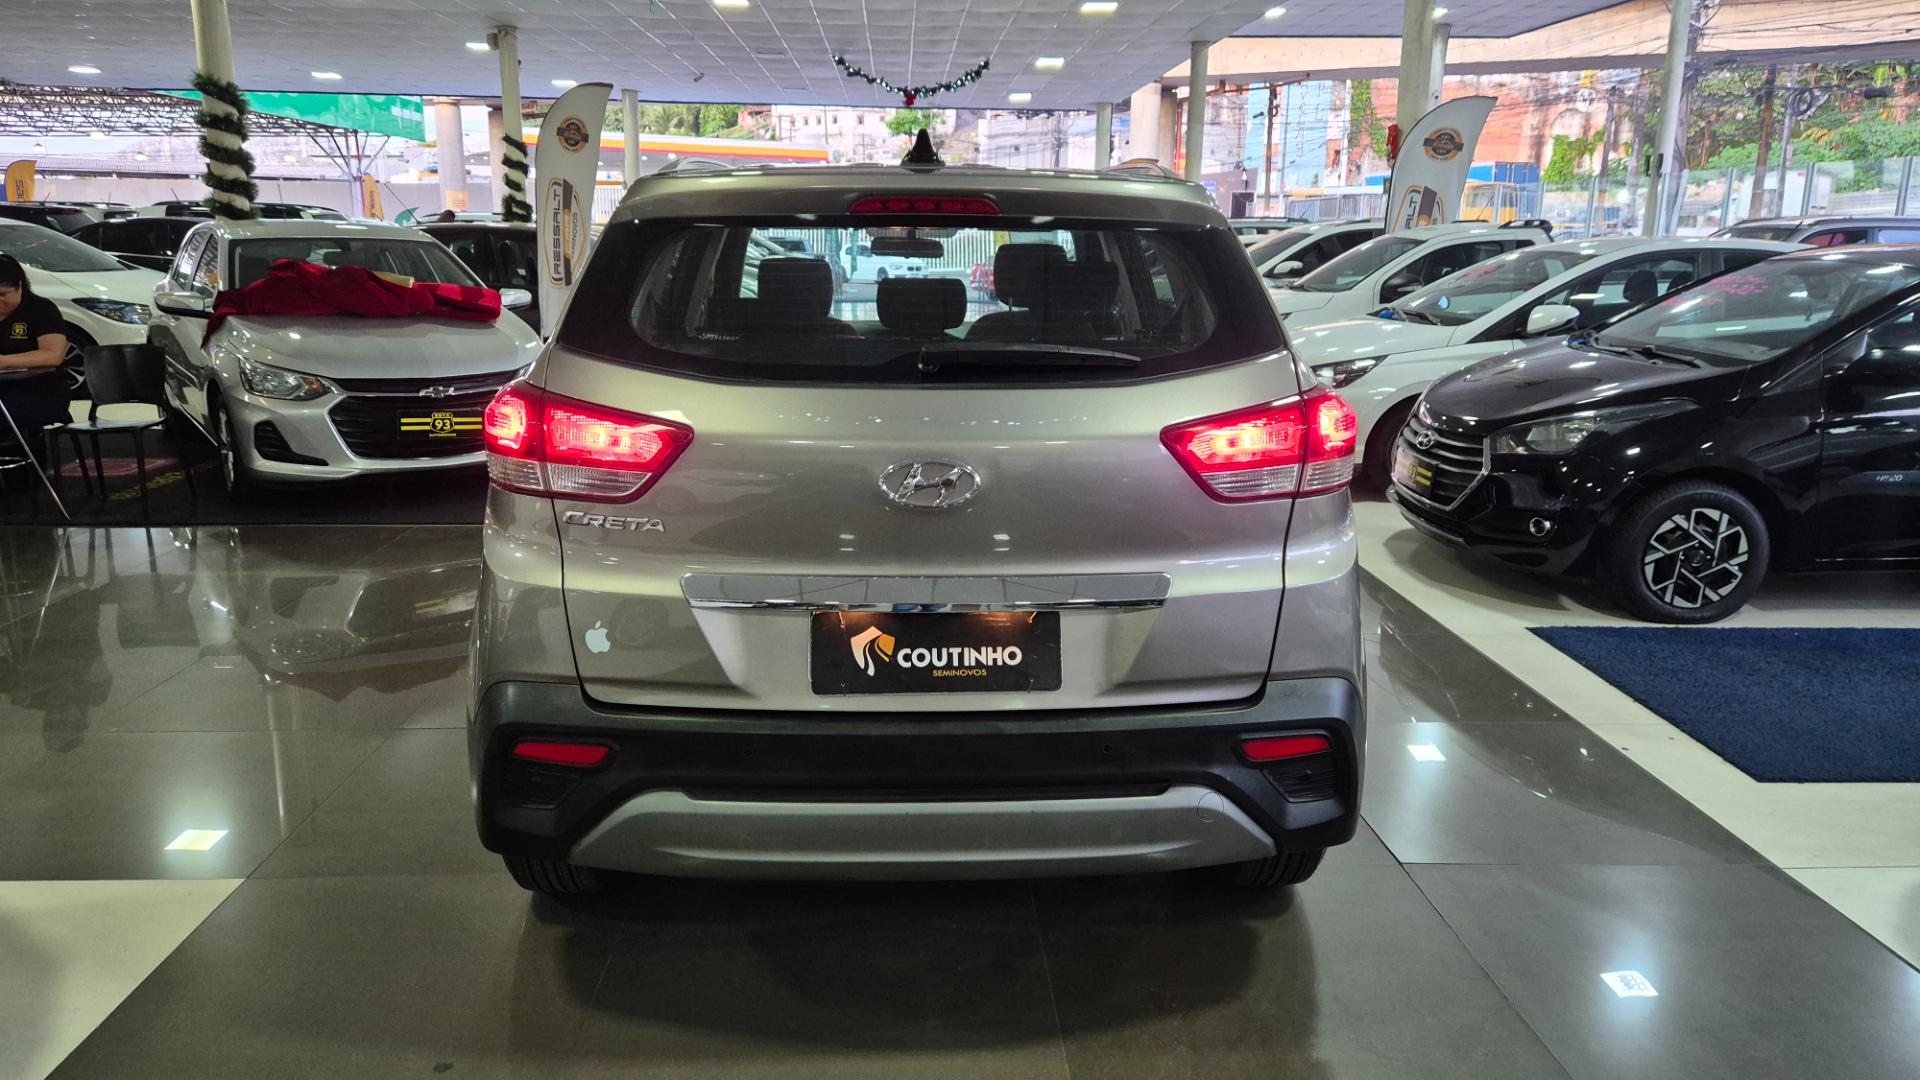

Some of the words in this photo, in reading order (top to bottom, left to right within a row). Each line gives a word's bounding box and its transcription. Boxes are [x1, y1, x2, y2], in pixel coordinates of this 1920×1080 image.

[552, 189, 561, 275] RESSALT
[434, 419, 451, 431] 93
[562, 511, 665, 532] CRETA
[897, 646, 1023, 668] COUTINHO
[932, 668, 987, 677] SEMINOVOS
